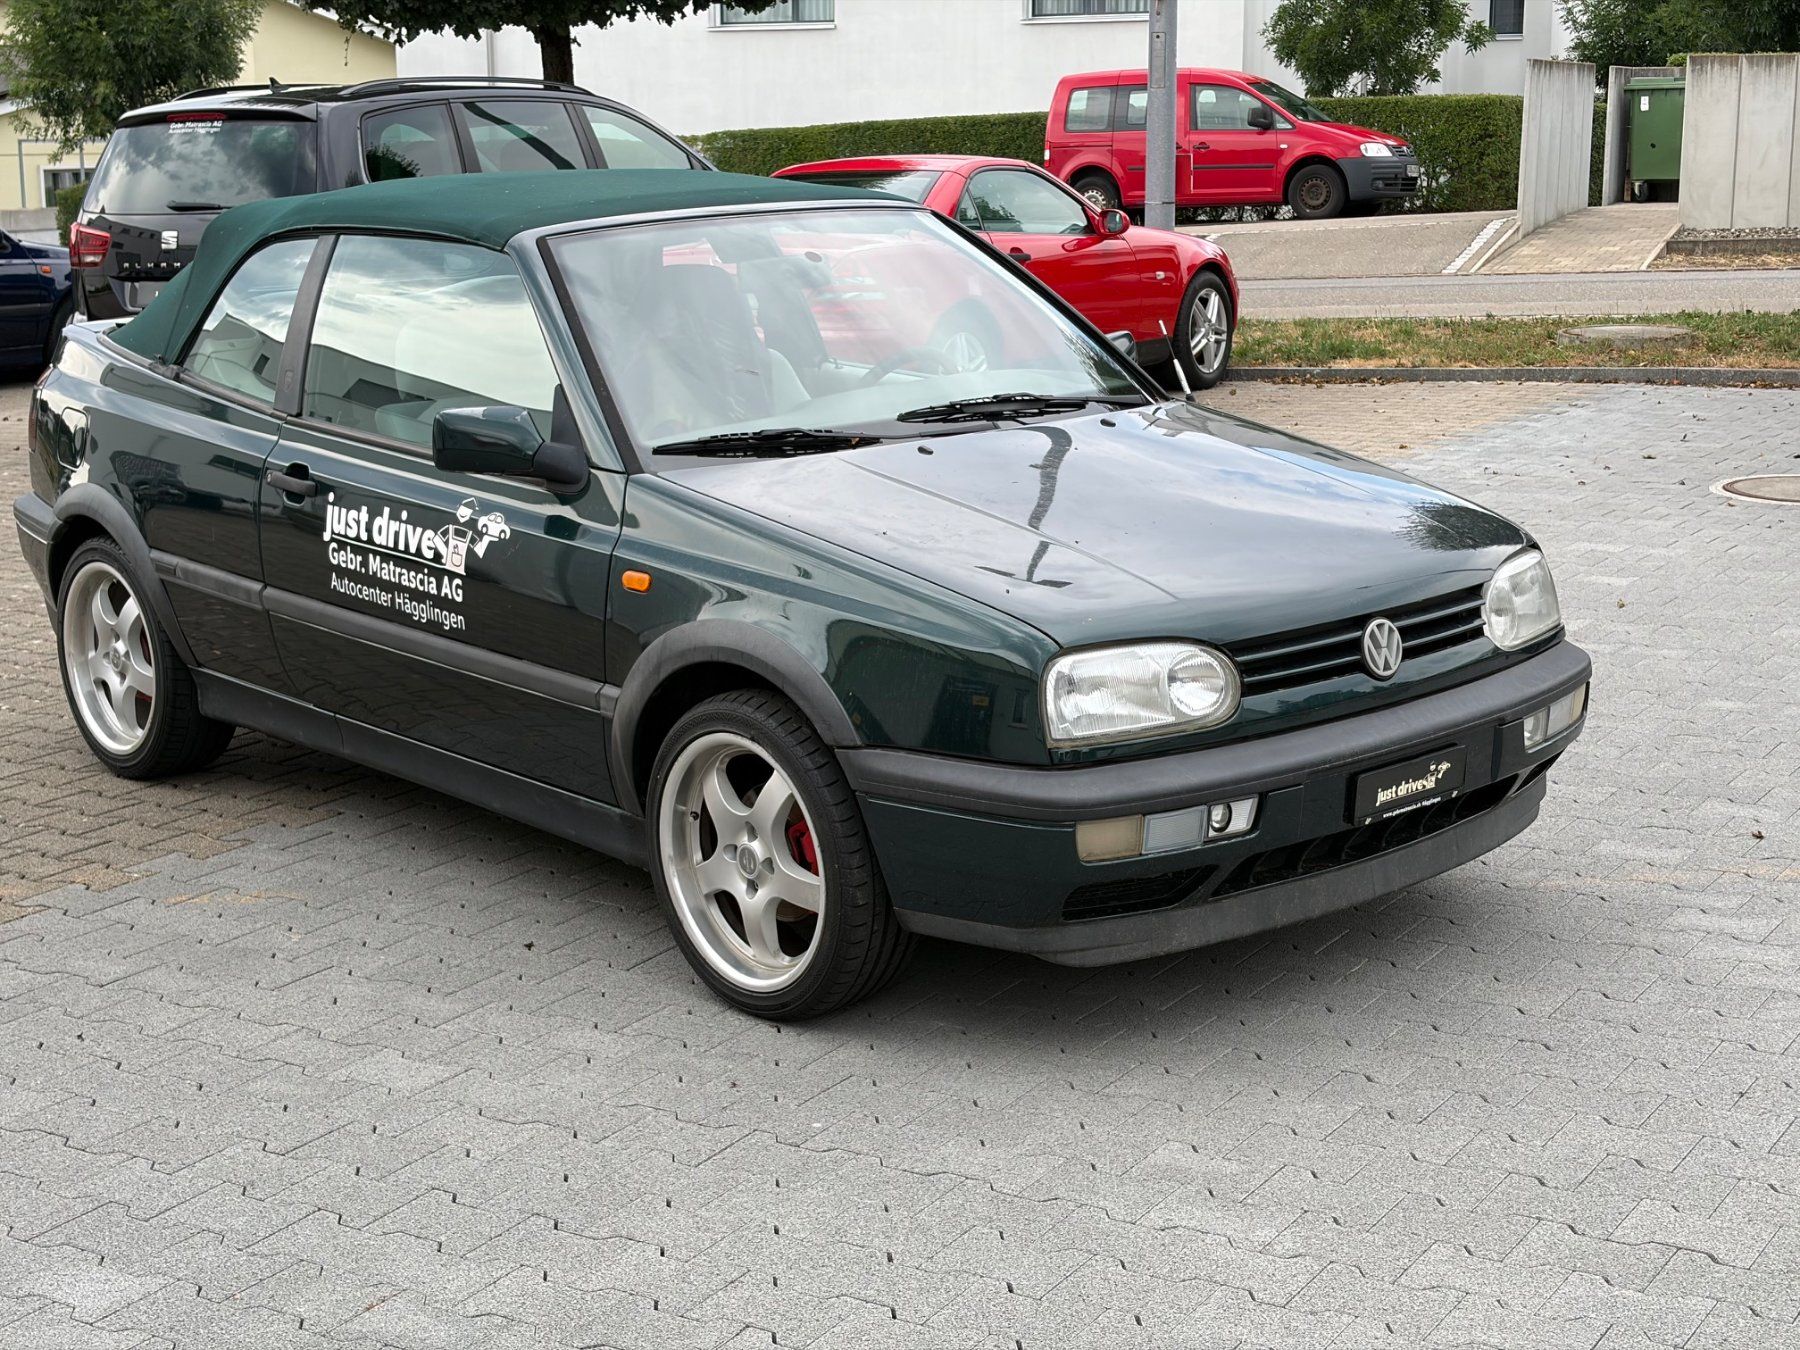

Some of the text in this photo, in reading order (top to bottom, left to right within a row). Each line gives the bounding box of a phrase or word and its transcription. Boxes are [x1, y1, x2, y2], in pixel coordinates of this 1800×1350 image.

[323, 491, 436, 560] just drive
[328, 542, 464, 603] Gebr. Matrascia AG
[331, 572, 466, 631] Autocenter Hägglingen
[1363, 618, 1403, 677] VW
[1376, 778, 1425, 807] just drive
